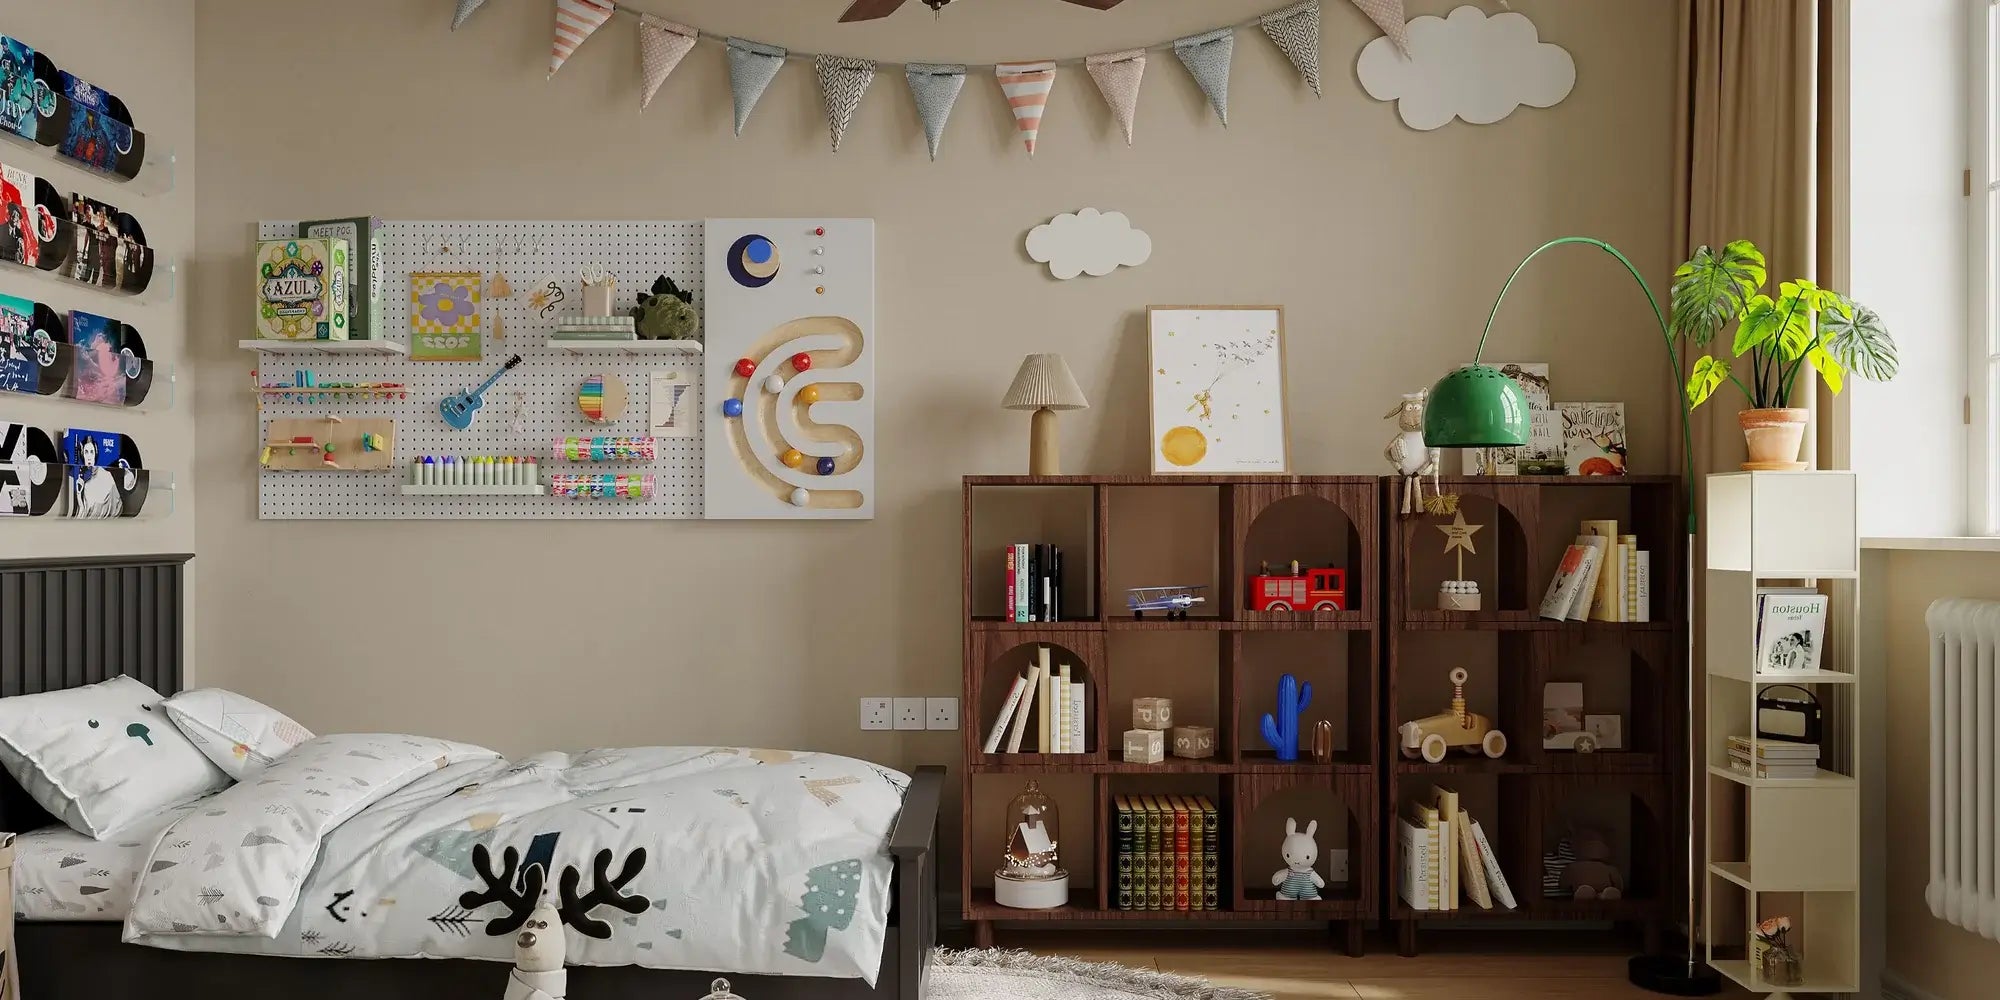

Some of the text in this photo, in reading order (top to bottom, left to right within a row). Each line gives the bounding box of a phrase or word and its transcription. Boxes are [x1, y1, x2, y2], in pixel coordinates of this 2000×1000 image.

[313, 227, 333, 238] MEET
[273, 280, 311, 297] AZUL
[1418, 845, 1427, 882] Persisted
